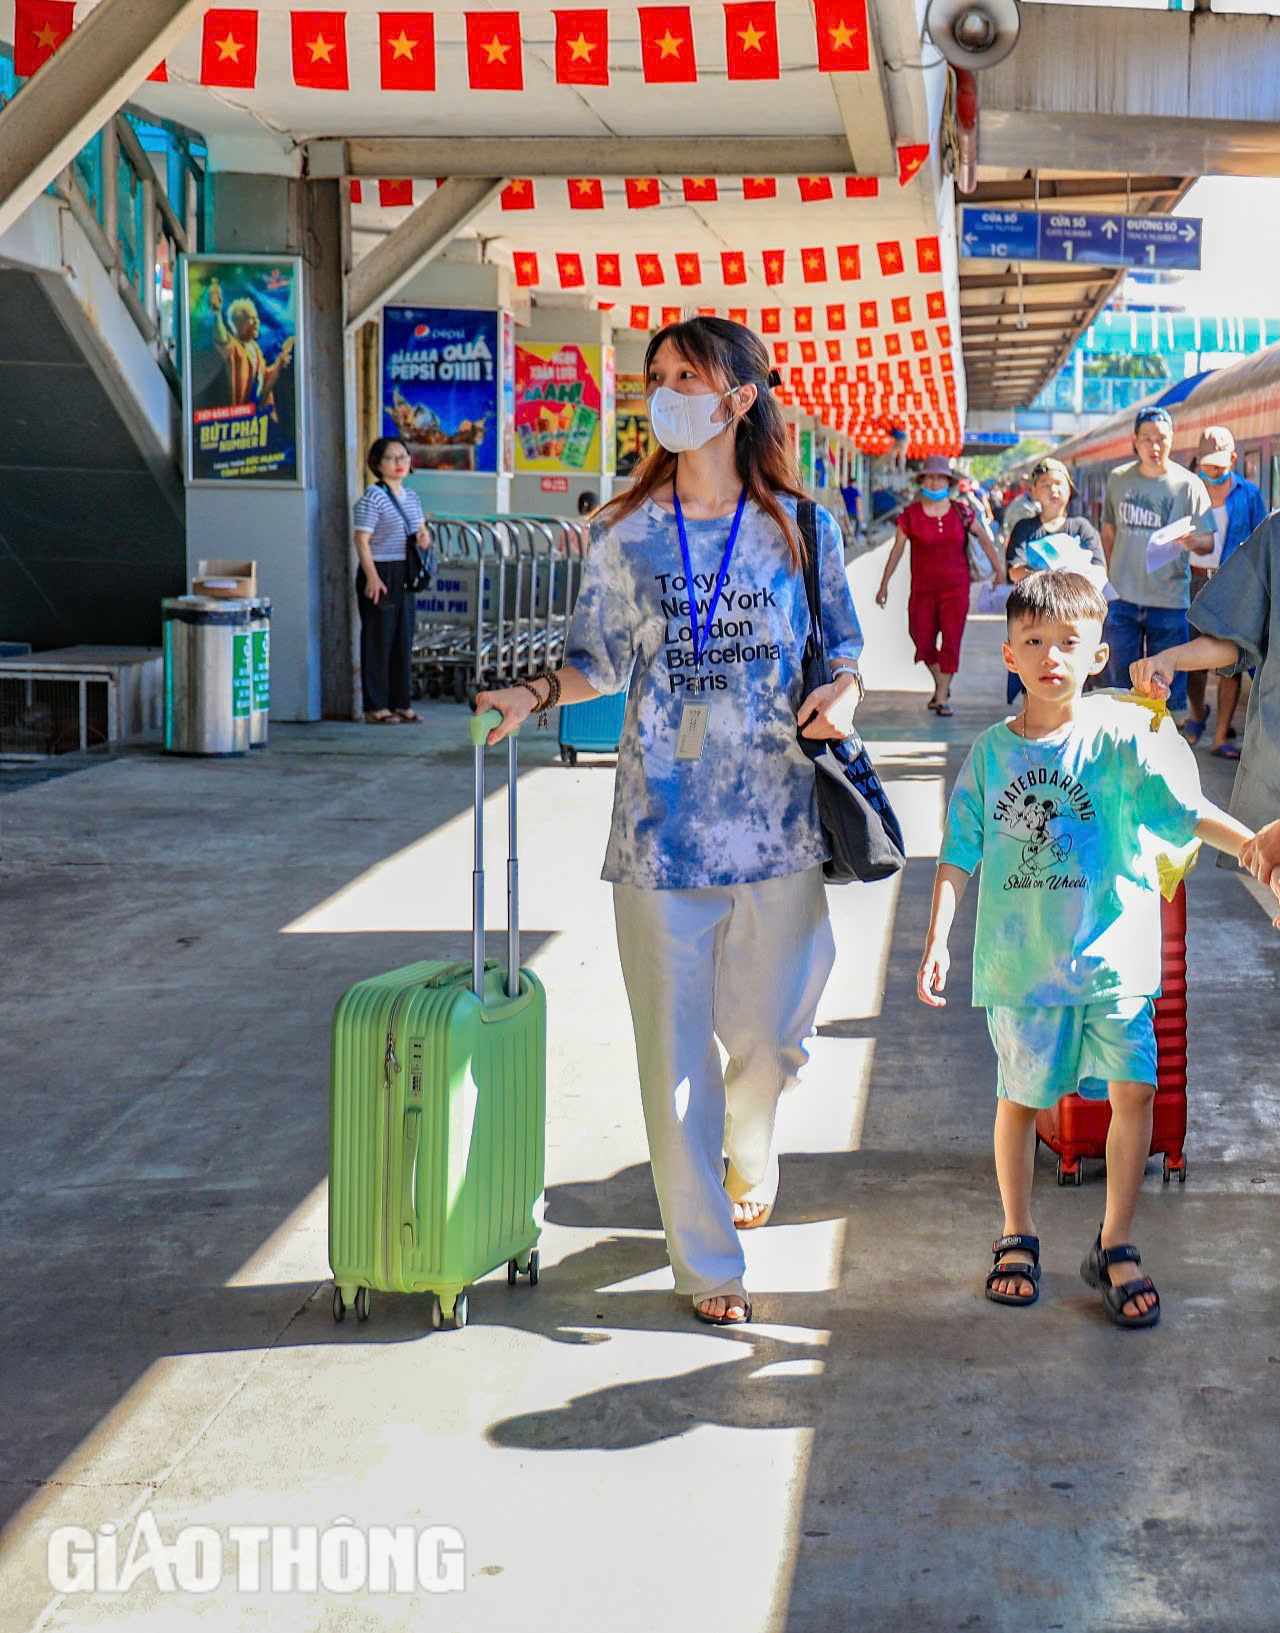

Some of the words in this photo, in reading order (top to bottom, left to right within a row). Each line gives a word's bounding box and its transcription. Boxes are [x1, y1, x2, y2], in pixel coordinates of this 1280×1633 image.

[1050, 215, 1071, 228] CỬA
[1062, 240, 1073, 261] 1
[1145, 244, 1156, 265] 1
[391, 361, 436, 380] PEPSI
[231, 416, 259, 439] PHÁ
[1119, 501, 1162, 528] SUMMER
[655, 572, 731, 594] Tokyo
[660, 597, 712, 619] New
[719, 587, 777, 612] York
[665, 642, 781, 669] Barcelona
[668, 670, 728, 694] Paris
[993, 768, 1097, 821] SKATEBOARDING
[1003, 874, 1031, 891] Skills
[1033, 880, 1045, 889] on
[1045, 874, 1088, 891] Wheels
